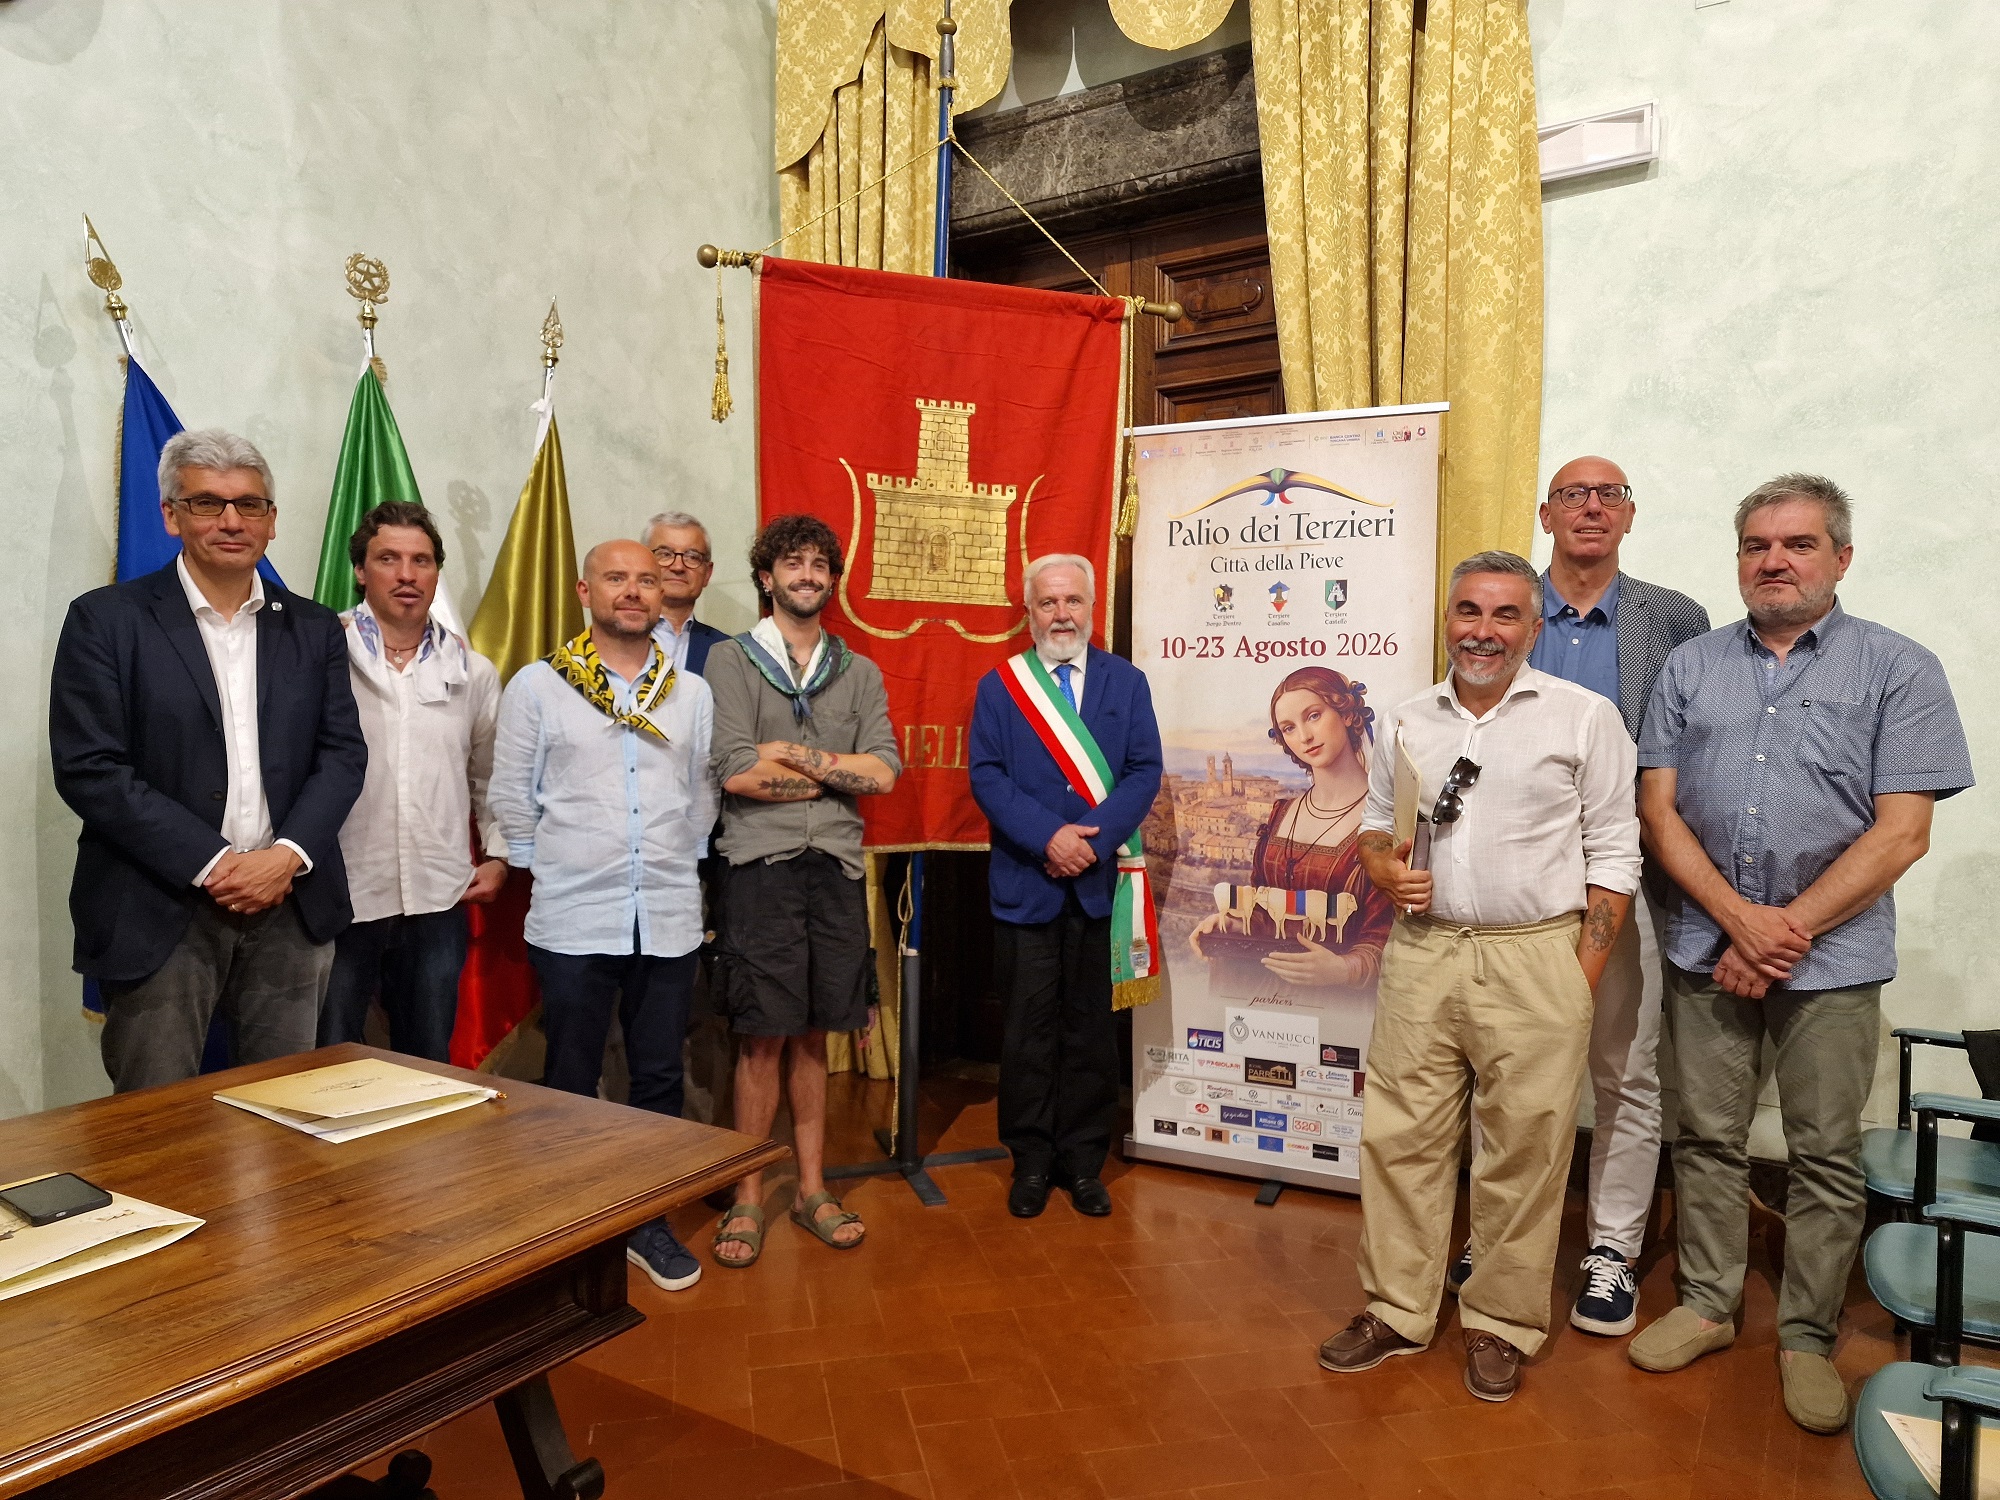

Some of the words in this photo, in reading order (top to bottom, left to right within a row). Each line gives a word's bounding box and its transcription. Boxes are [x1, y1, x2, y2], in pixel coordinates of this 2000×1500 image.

[1167, 518, 1230, 547] Palio
[1240, 515, 1280, 543] dei
[1289, 508, 1395, 541] Terzieri
[1210, 555, 1249, 574] Città
[1255, 554, 1294, 572] della
[1300, 552, 1344, 570] Pieve
[1160, 635, 1225, 659] 10-23
[1233, 635, 1327, 664] Agosto
[1336, 632, 1399, 657] 2026
[1249, 992, 1293, 1007] partners
[1198, 1037, 1222, 1049] TICIS
[1251, 1029, 1316, 1045] VANNUCCI
[1248, 1068, 1292, 1081] PARRETTI
